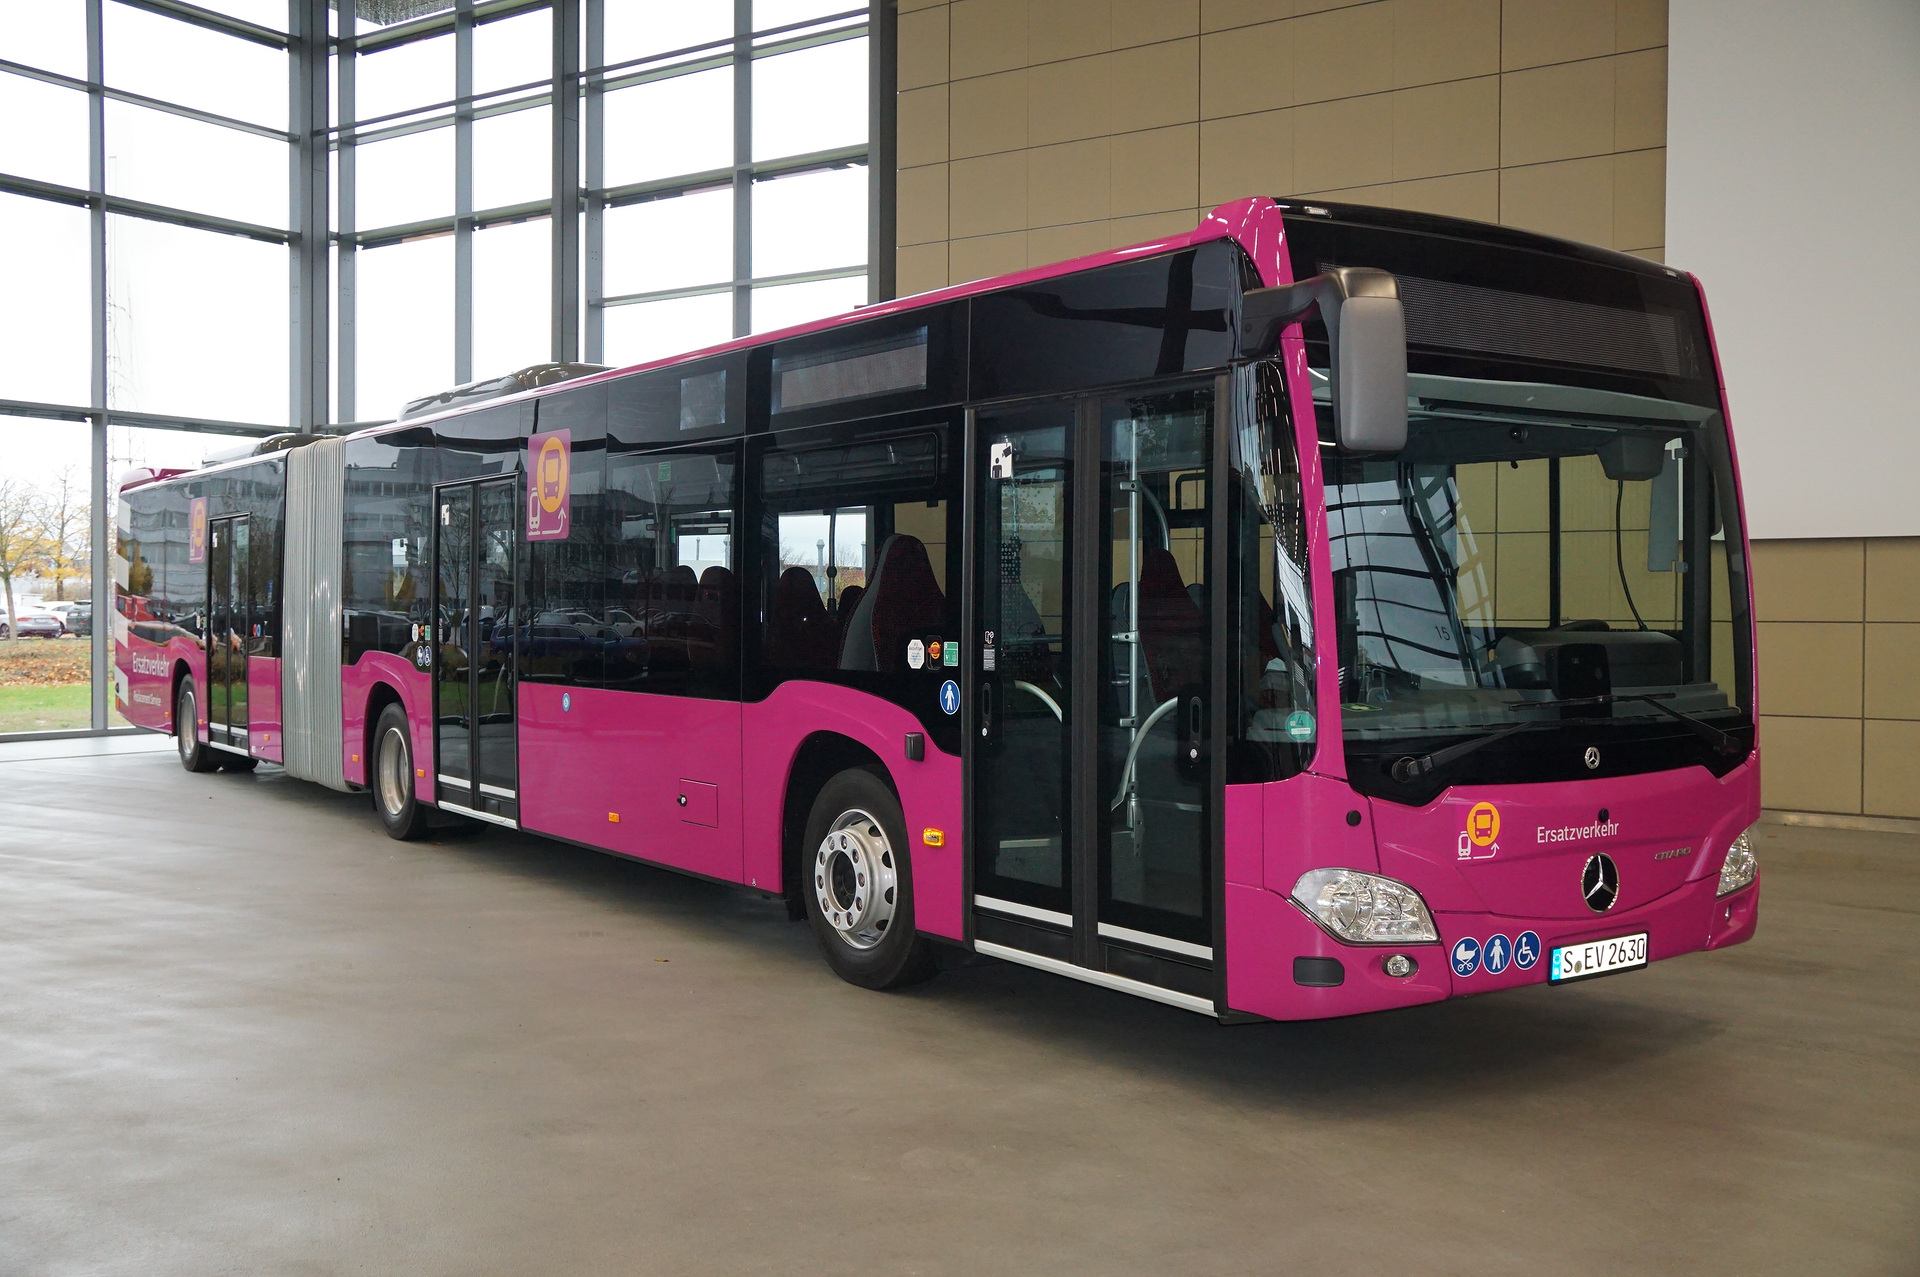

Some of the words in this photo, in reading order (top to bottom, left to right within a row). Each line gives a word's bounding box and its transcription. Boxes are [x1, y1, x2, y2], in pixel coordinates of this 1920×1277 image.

[133, 652, 169, 677] Ersatzverkehr
[1537, 819, 1619, 844] Ersatzverkehr
[1654, 846, 1692, 861] CITARO
[1563, 950, 1573, 973] S
[1584, 945, 1605, 970] EV
[1608, 938, 1646, 966] 2630
